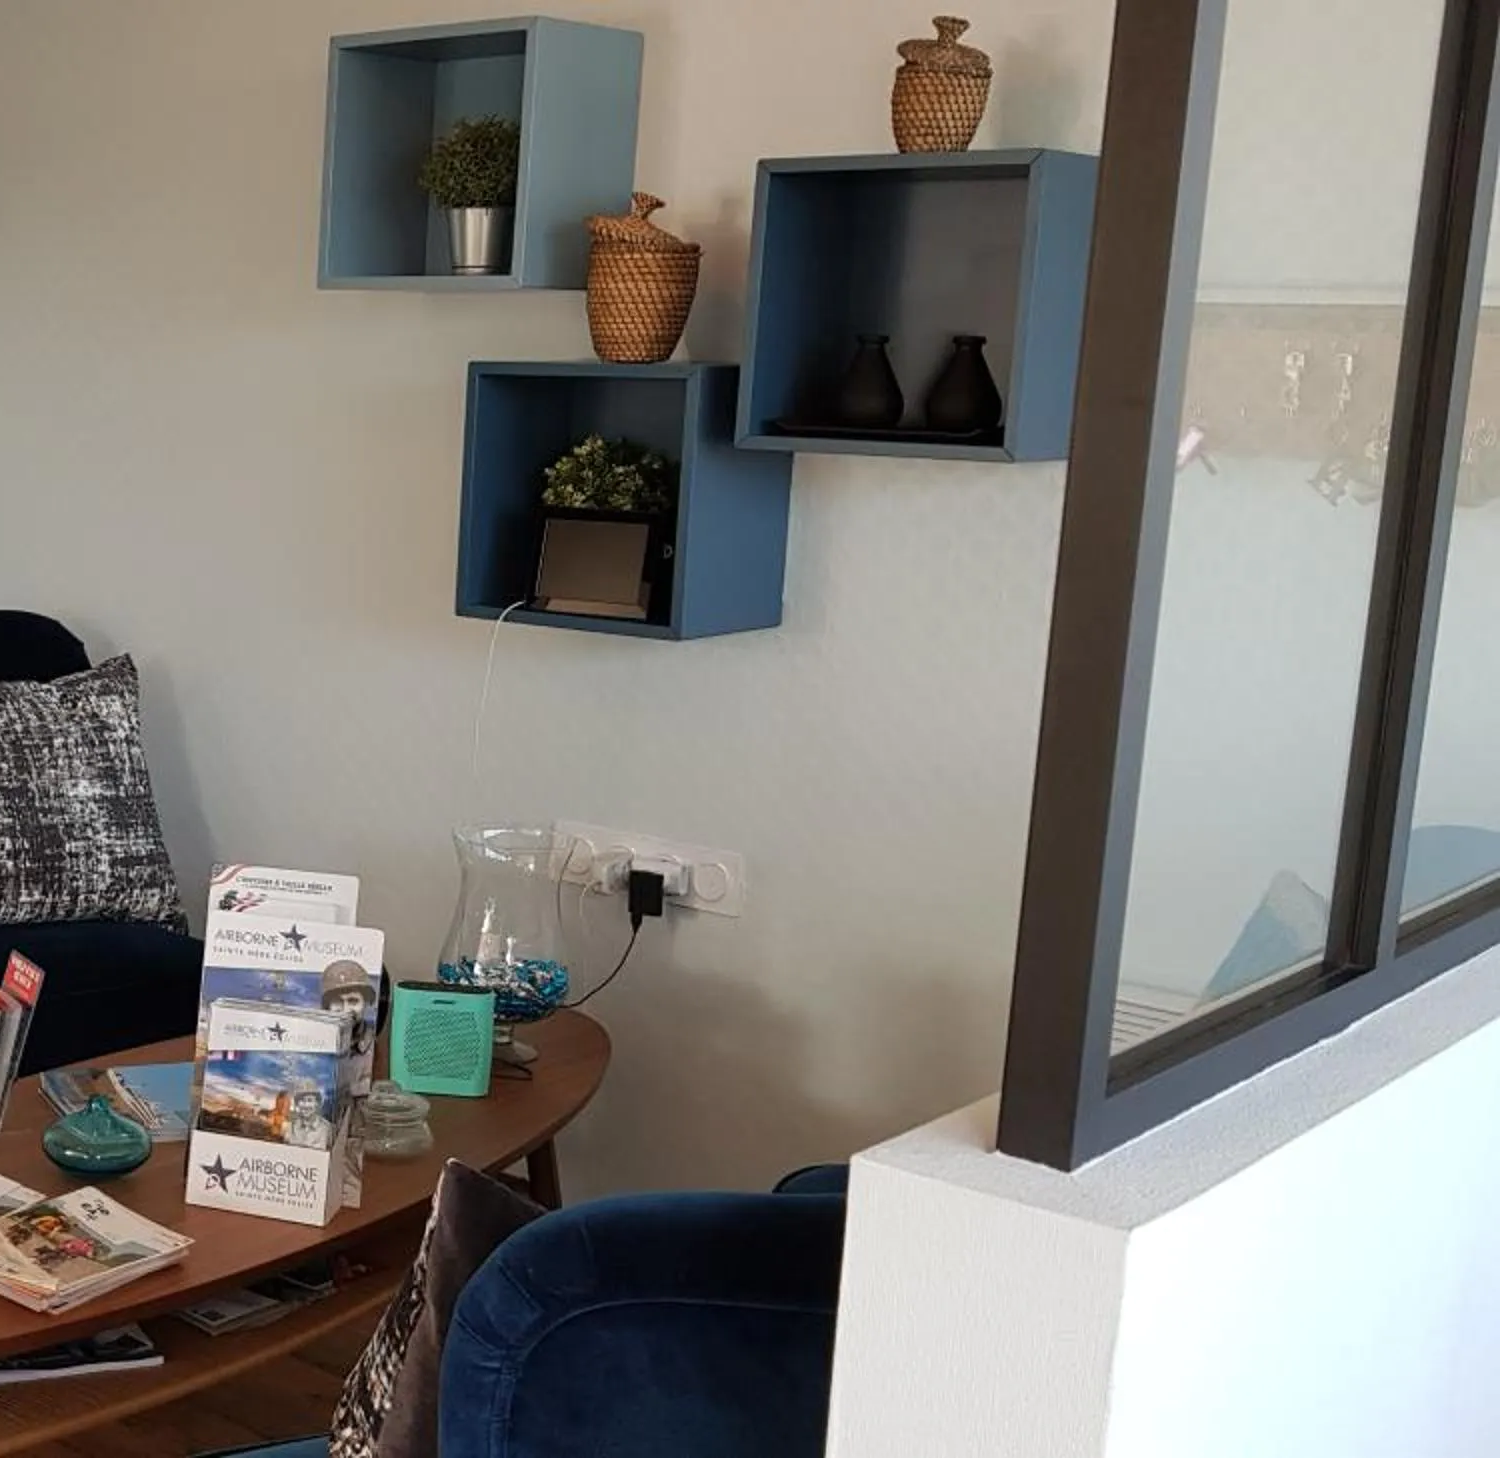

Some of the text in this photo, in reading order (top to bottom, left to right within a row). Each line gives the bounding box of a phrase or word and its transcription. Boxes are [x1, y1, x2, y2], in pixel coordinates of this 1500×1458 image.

[215, 928, 365, 958] AIRBORNE MUSEUM
[239, 1158, 318, 1183] AIRBORNE
[236, 1173, 317, 1201] MUSEUM
